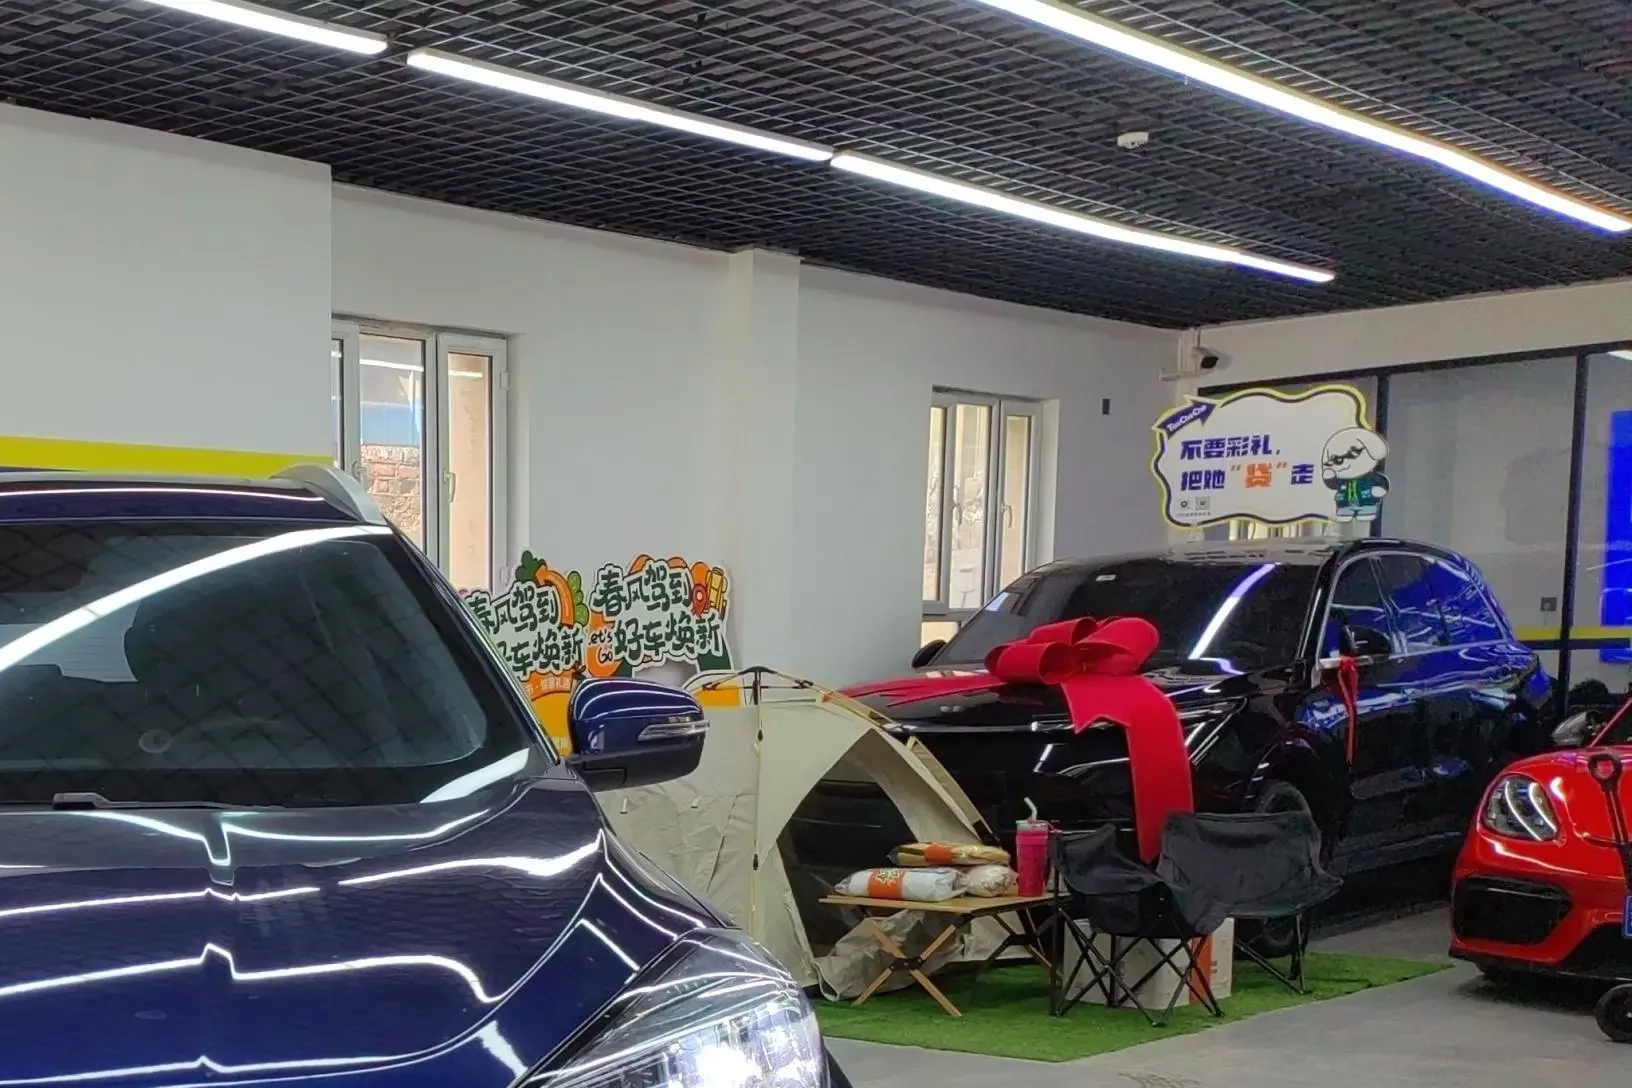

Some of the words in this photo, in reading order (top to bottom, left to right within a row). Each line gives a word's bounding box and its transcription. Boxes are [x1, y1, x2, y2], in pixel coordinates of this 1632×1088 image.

[593, 565, 692, 617] 春风驾到
[588, 628, 613, 645] et's
[614, 611, 720, 661] 好车焕新
